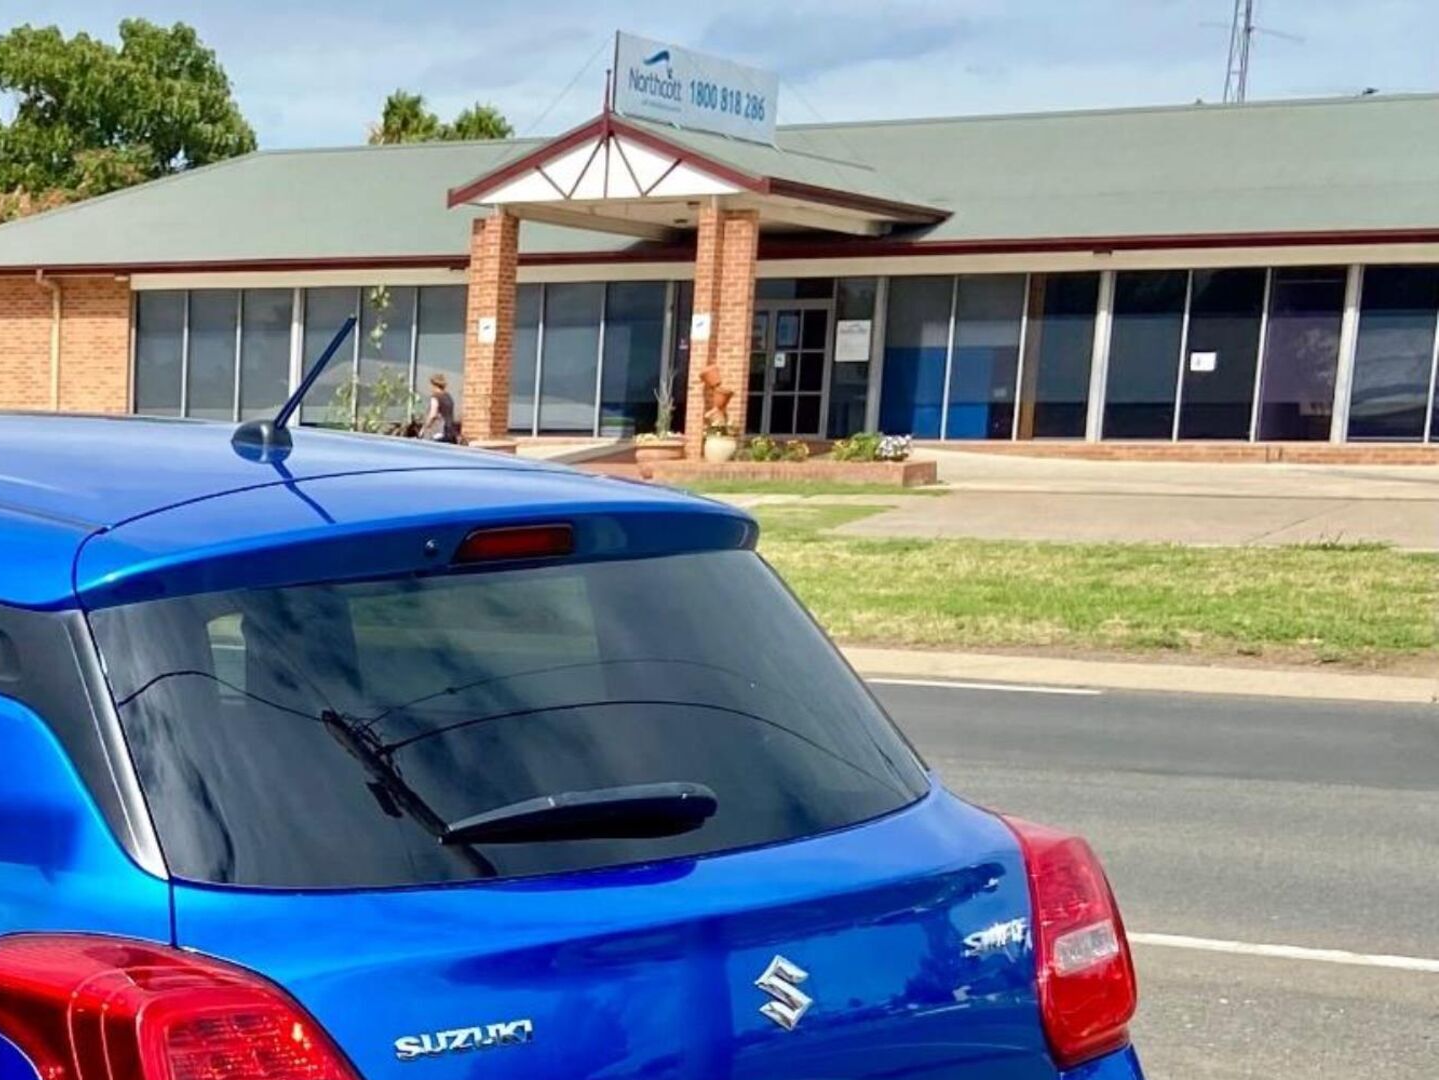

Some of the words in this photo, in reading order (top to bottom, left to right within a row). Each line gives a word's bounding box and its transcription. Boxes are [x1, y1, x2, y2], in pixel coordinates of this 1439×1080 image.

[629, 67, 682, 101] Northcott
[690, 79, 718, 110] 1800
[721, 87, 742, 115] 818
[744, 92, 766, 121] 286
[394, 1019, 533, 1060] SUZUKI
